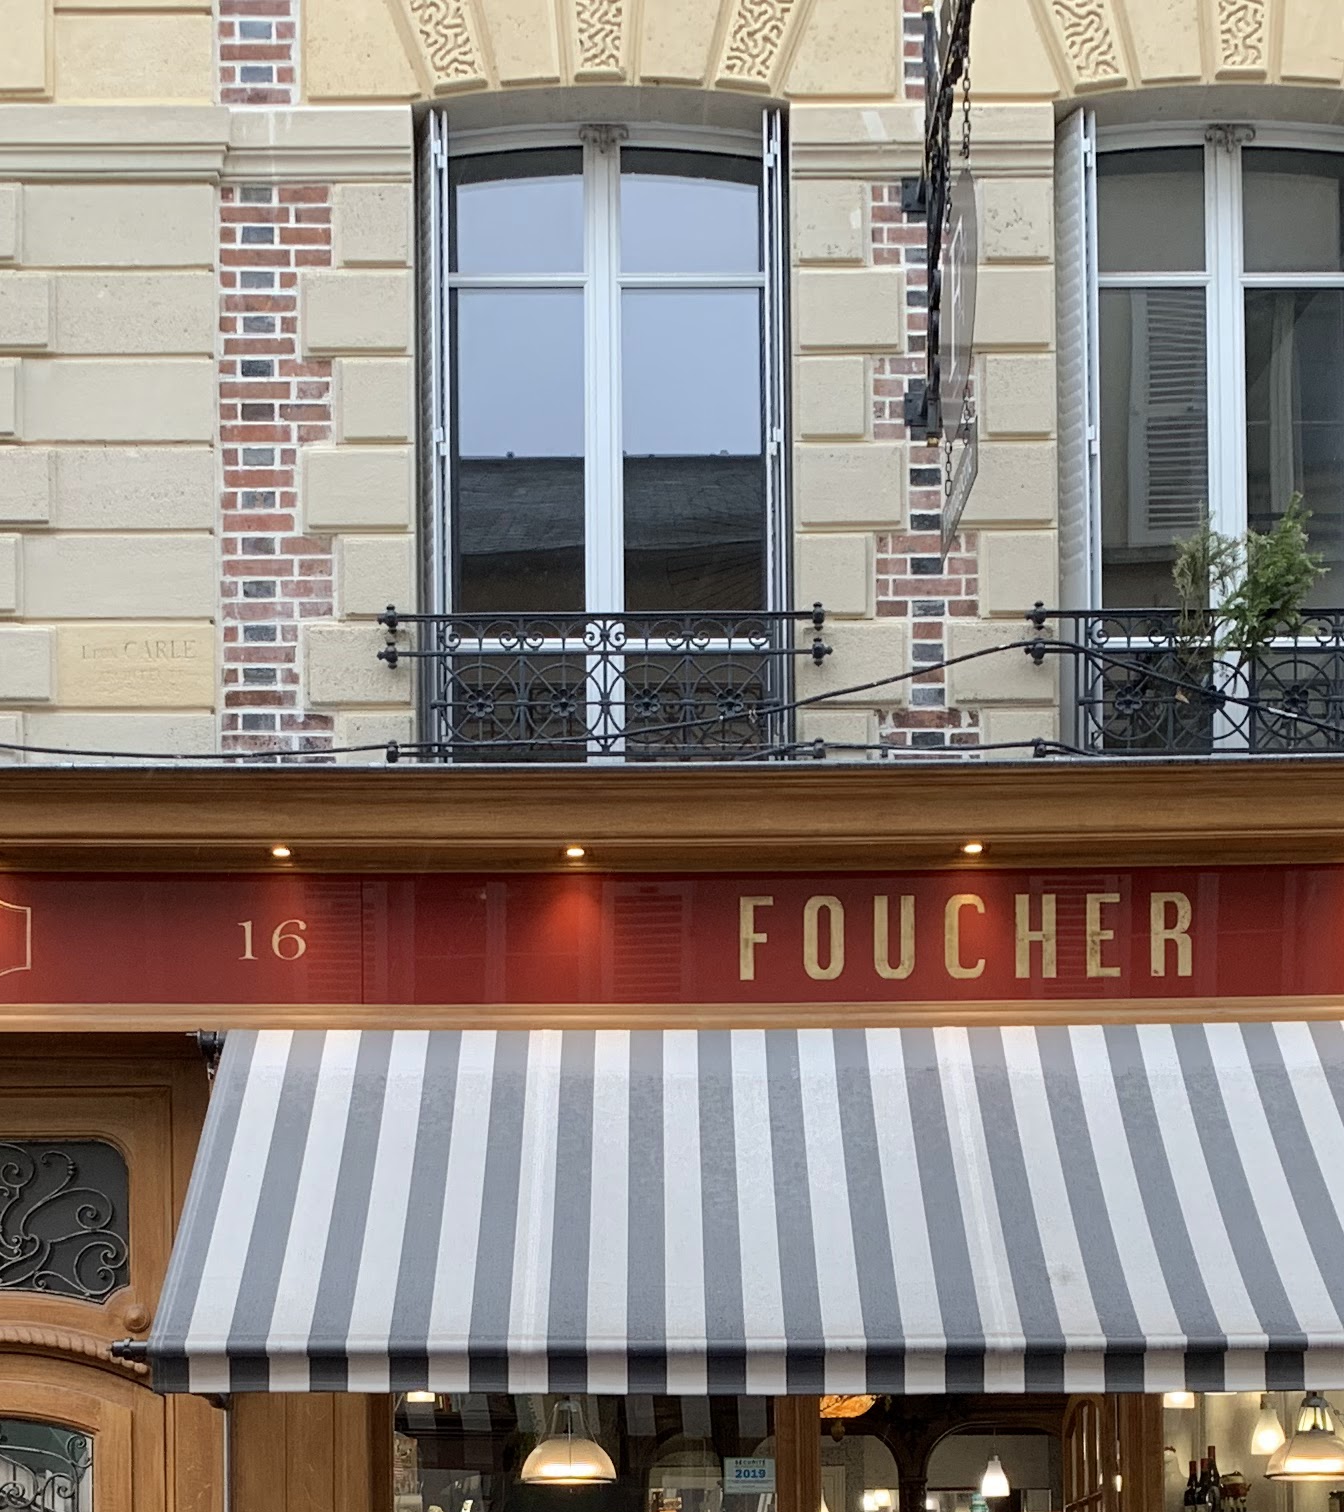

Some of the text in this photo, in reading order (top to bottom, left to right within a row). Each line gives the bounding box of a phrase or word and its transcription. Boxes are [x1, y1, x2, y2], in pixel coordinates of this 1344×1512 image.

[123, 639, 198, 661] CARLE
[236, 918, 308, 962] 16
[739, 890, 1196, 982] FOUCHER
[735, 1469, 767, 1479] 2019
